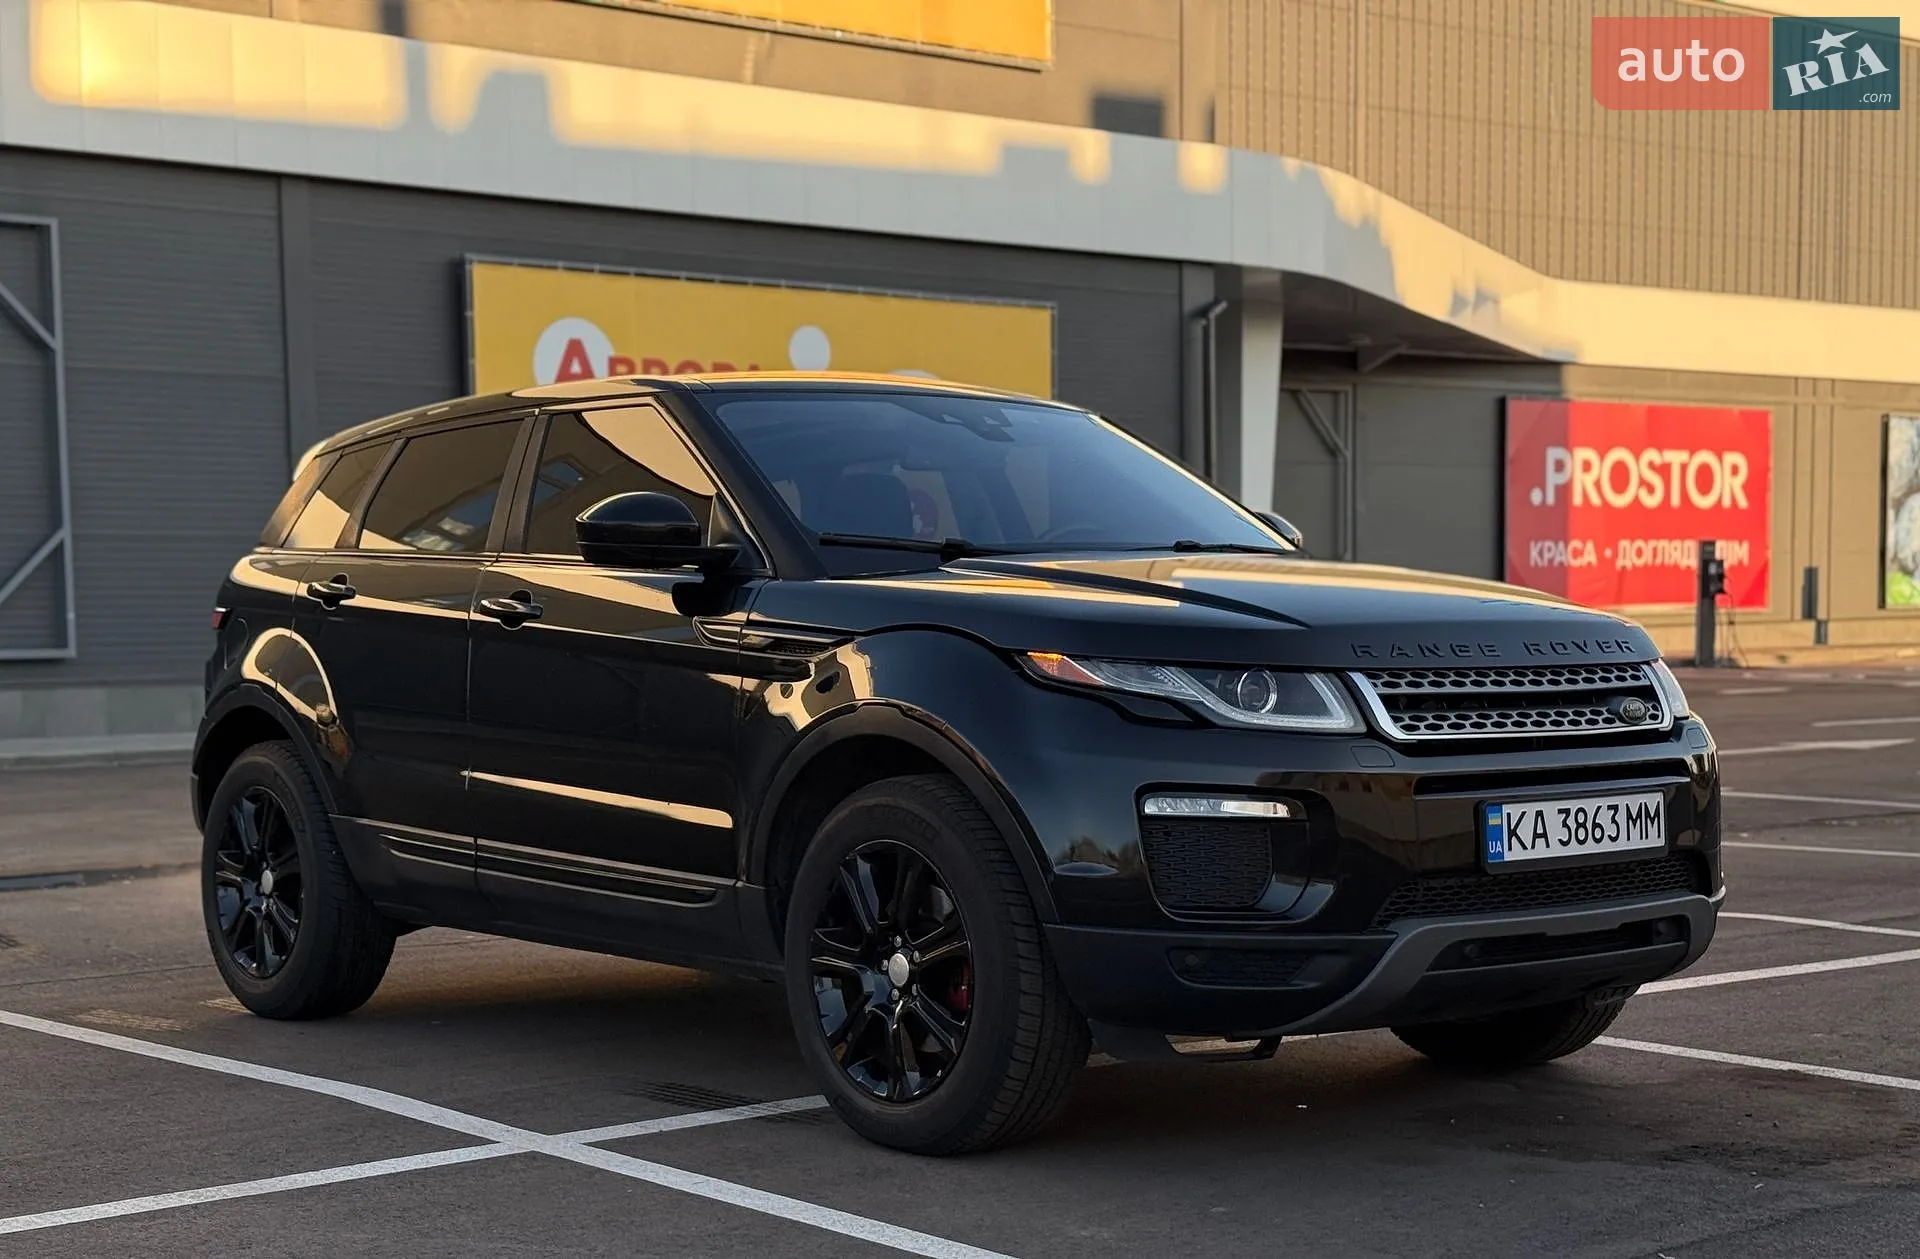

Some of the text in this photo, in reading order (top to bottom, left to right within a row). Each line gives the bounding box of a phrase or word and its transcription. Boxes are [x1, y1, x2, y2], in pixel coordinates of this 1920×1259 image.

[1529, 446, 1749, 509] .PROSTOR
[1529, 539, 1598, 567] КРАСА
[1616, 539, 1698, 570] ДОГЛЯД
[1350, 638, 1635, 658] RANGE ROVER
[1506, 800, 1661, 852] KA 3863 MM
[1489, 840, 1503, 854] UA
